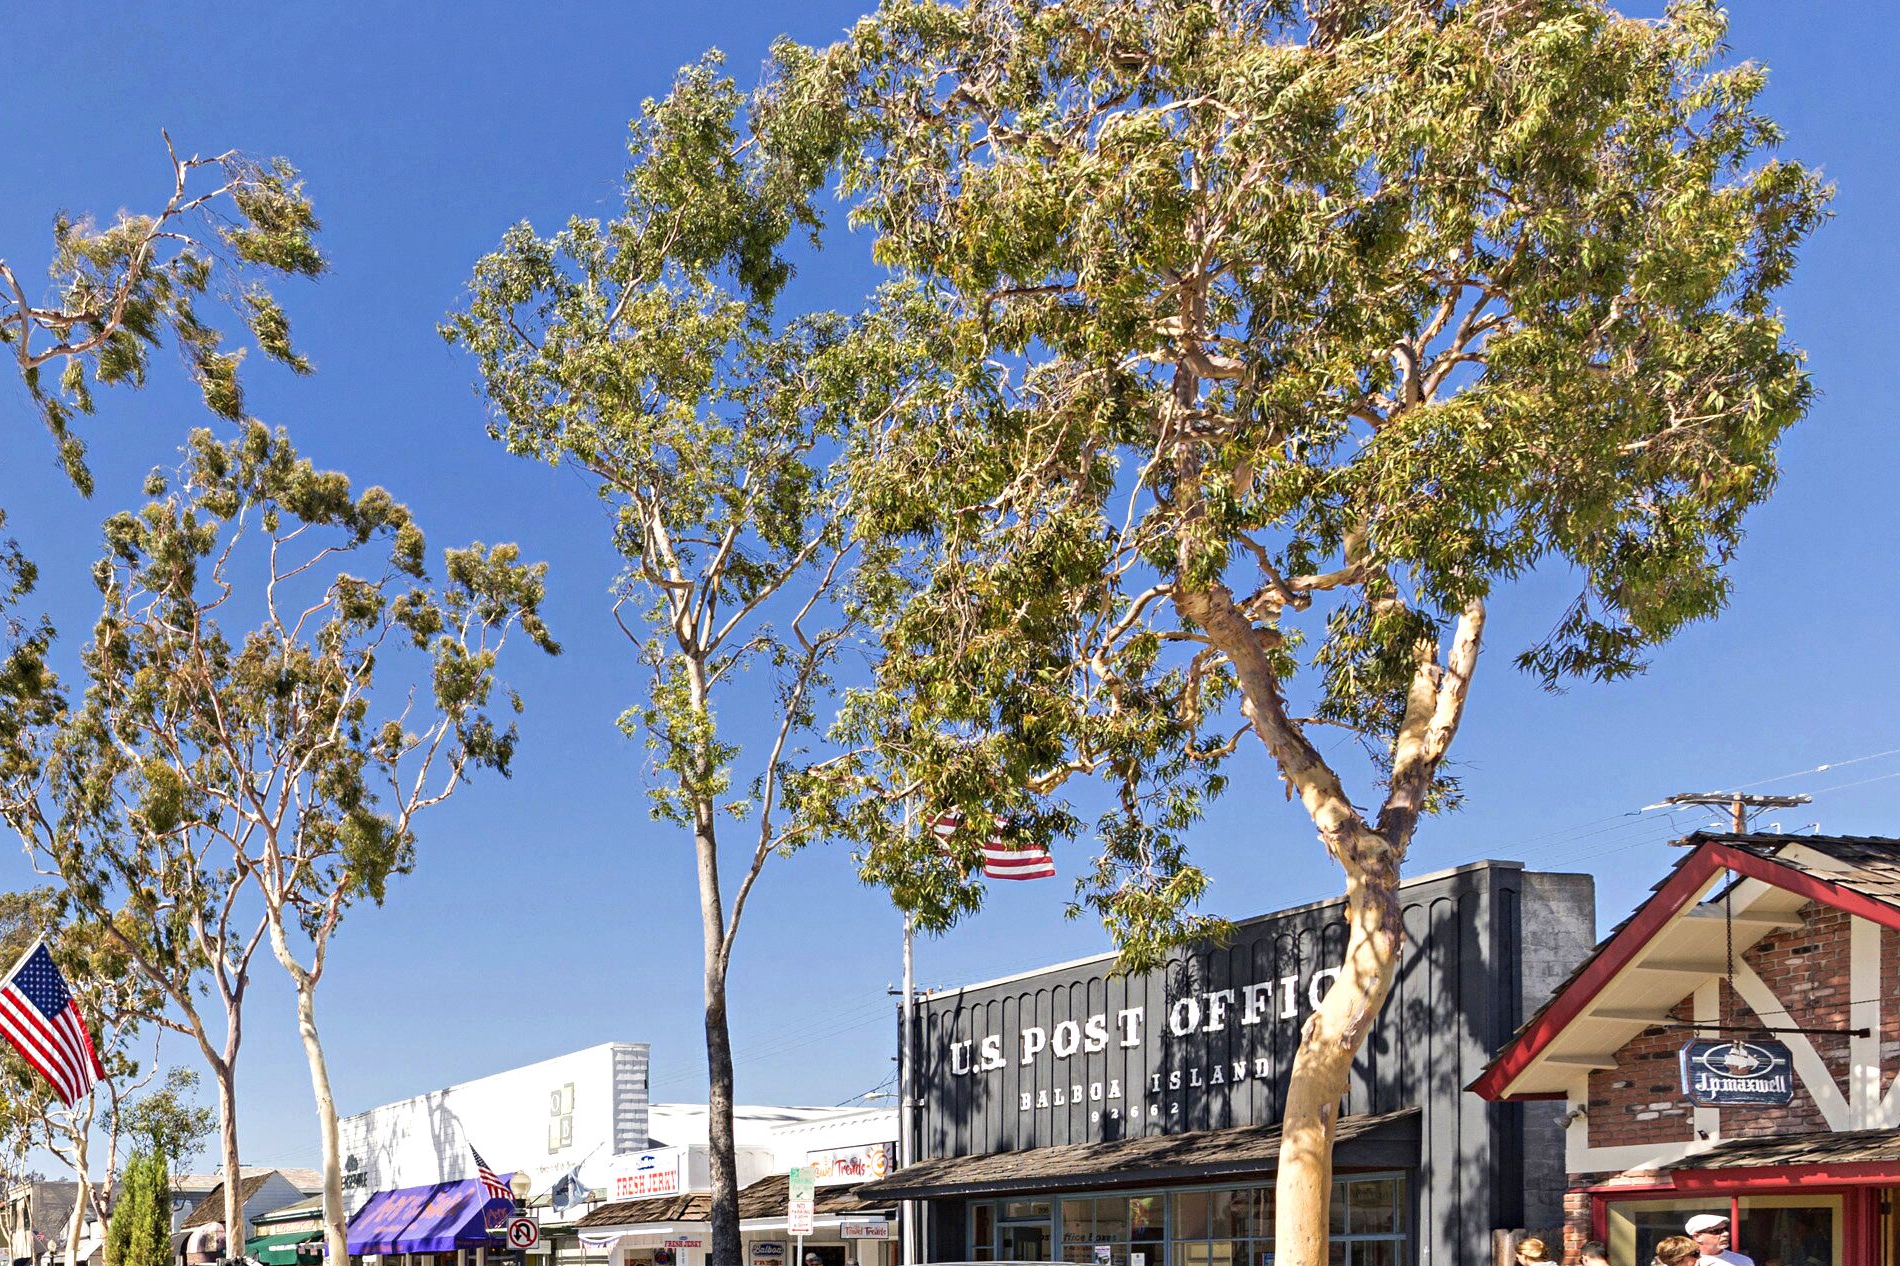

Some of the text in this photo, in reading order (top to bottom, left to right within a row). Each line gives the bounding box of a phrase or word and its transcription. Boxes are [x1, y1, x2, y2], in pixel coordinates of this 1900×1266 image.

[950, 965, 1341, 1076] U.S. POST OFFIC
[1020, 1057, 1270, 1112] BALBOA ISLAND
[1091, 1102, 1180, 1123] 92662
[616, 1170, 677, 1196] FRESH JERKY
[753, 1243, 783, 1255] Balboa
